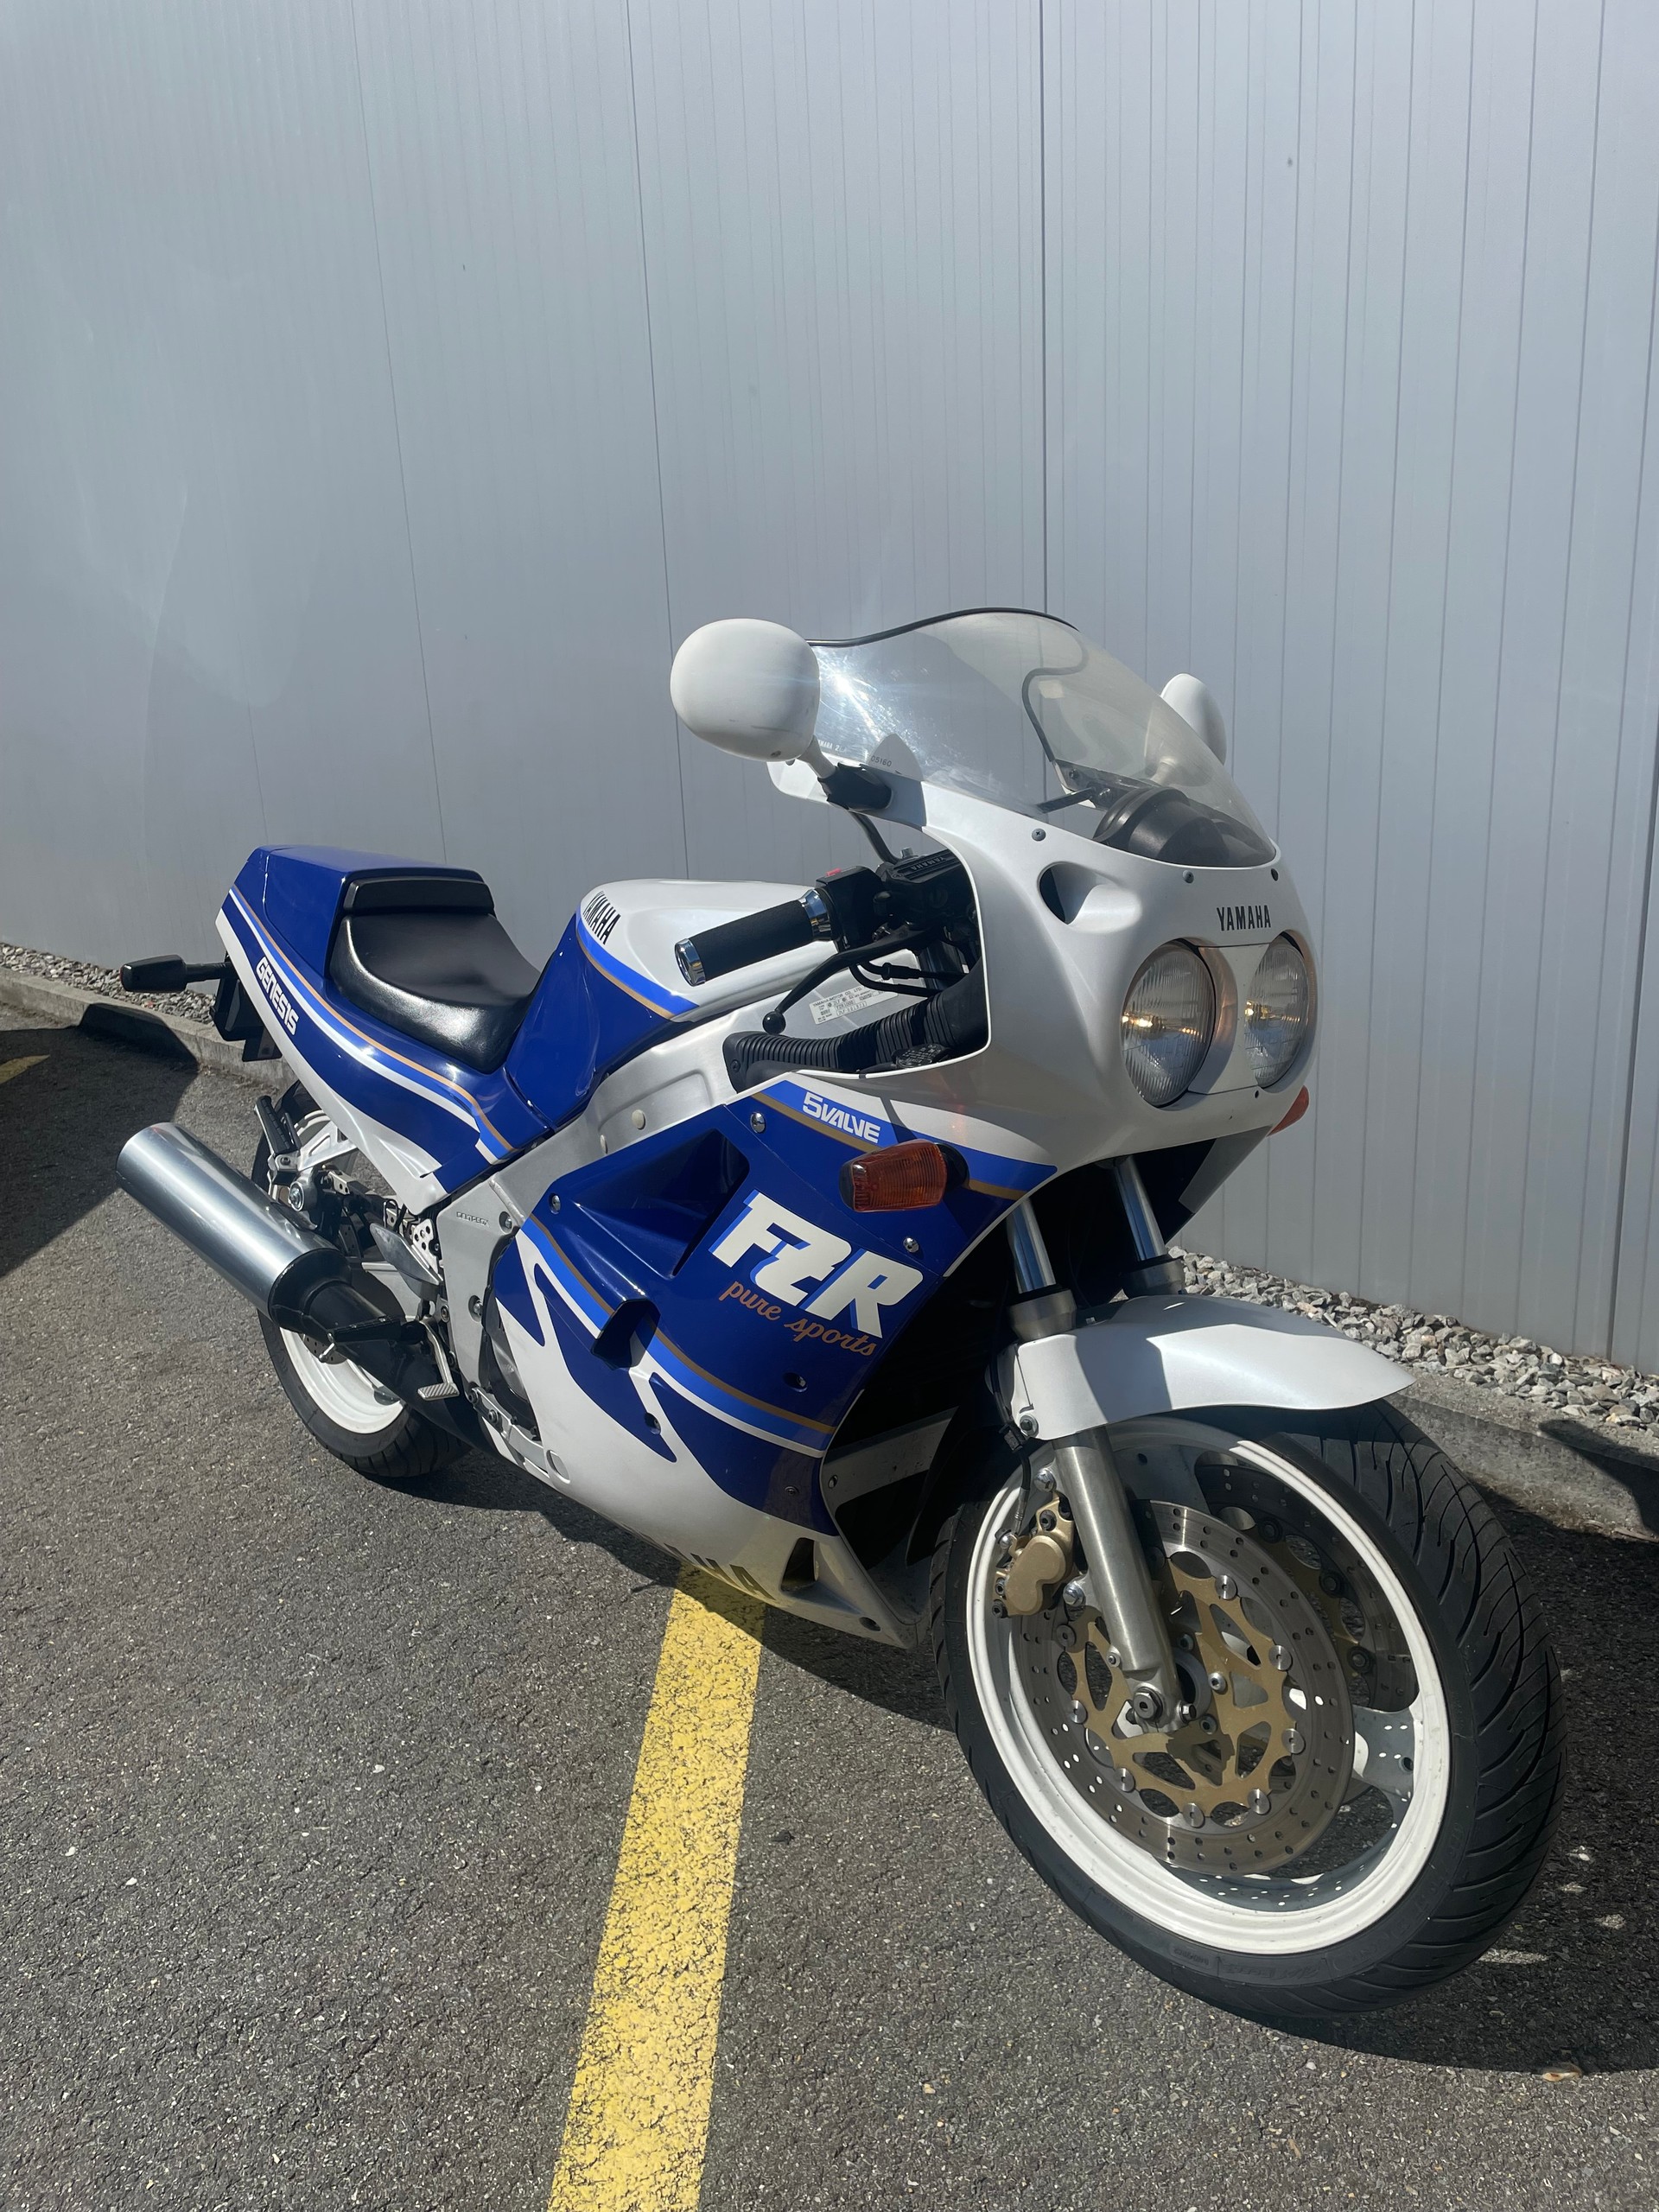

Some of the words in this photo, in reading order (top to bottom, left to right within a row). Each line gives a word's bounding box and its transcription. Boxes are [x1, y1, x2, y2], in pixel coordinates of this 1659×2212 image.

[870, 755, 892, 767] 05160
[911, 855, 944, 871] YAMAHA
[582, 890, 621, 944] YAMAHA
[1216, 905, 1271, 931] YAMAHA
[256, 957, 299, 1035] GENESIS
[709, 1189, 924, 1338] FZR
[718, 1281, 781, 1320] pure
[784, 1318, 877, 1357] sports
